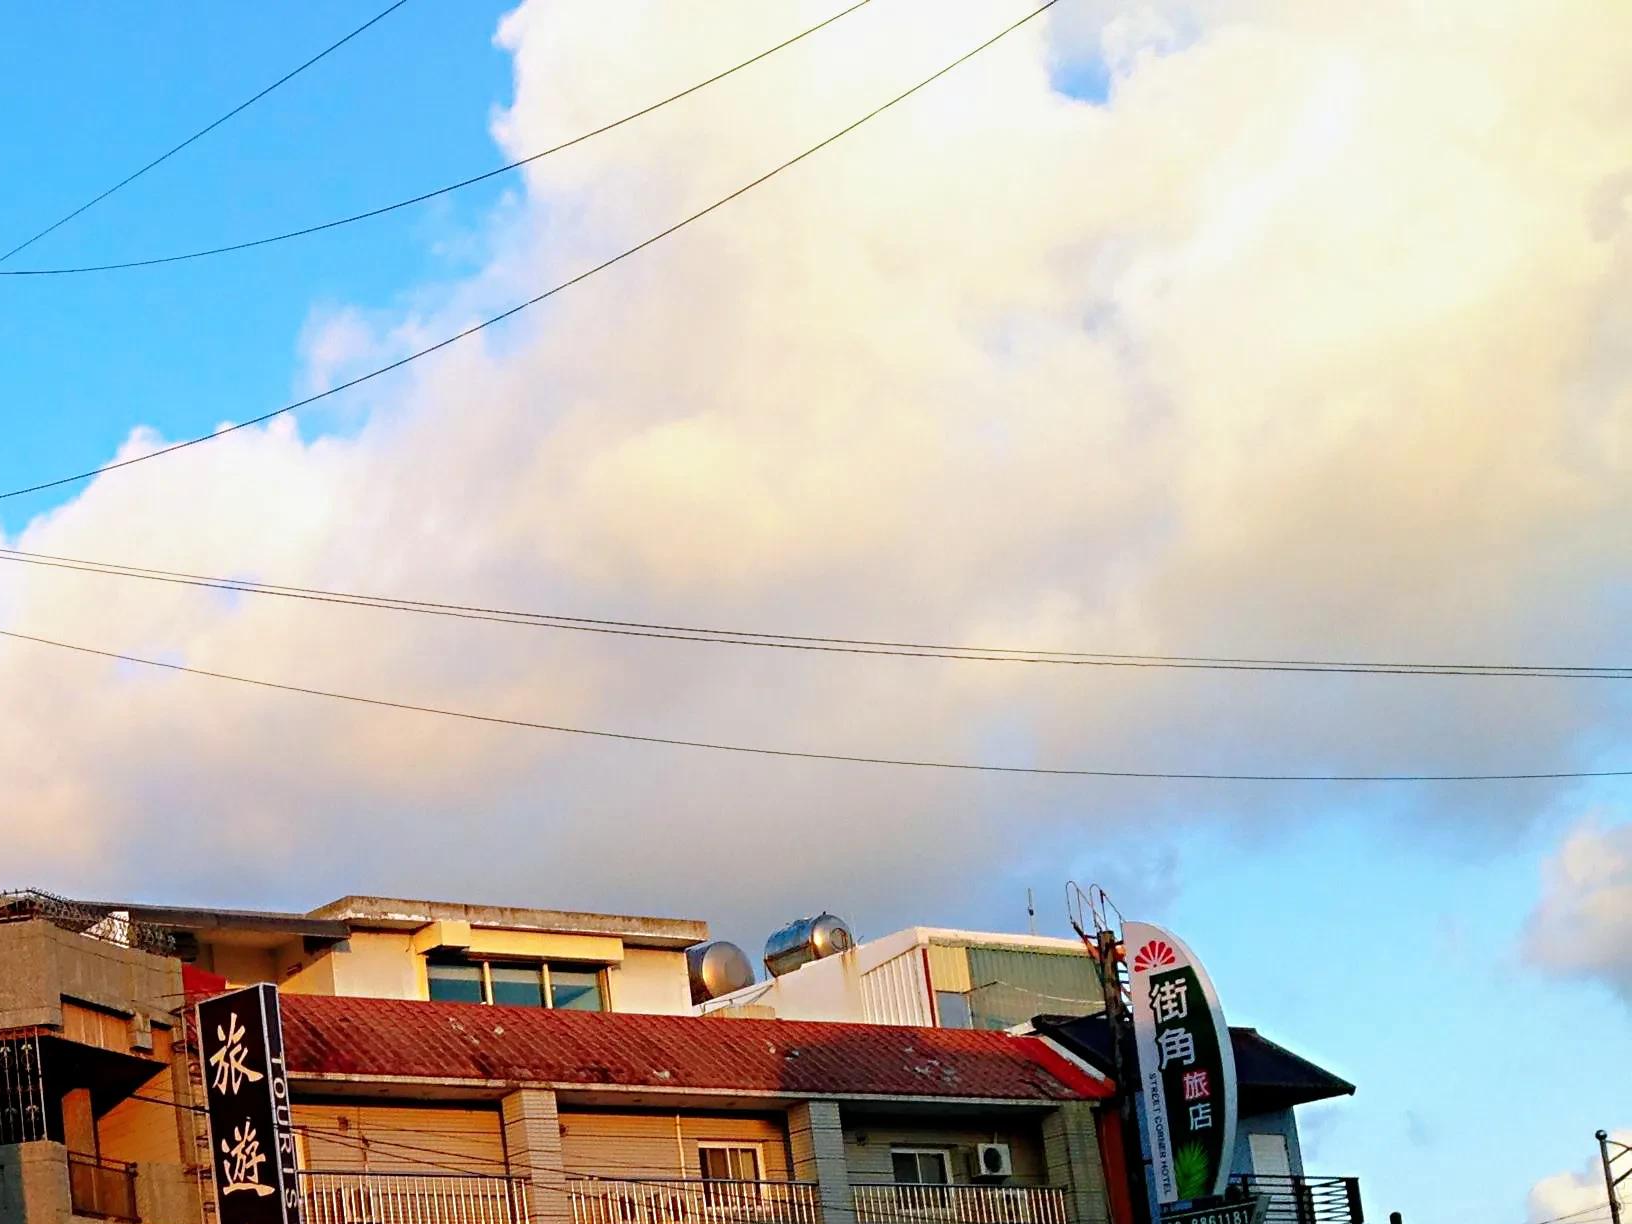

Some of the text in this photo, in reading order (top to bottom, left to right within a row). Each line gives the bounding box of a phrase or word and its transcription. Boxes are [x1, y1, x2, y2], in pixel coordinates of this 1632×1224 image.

[1149, 977, 1215, 1132] 街角旅店
[1161, 1160, 1173, 1195] HOTEL
